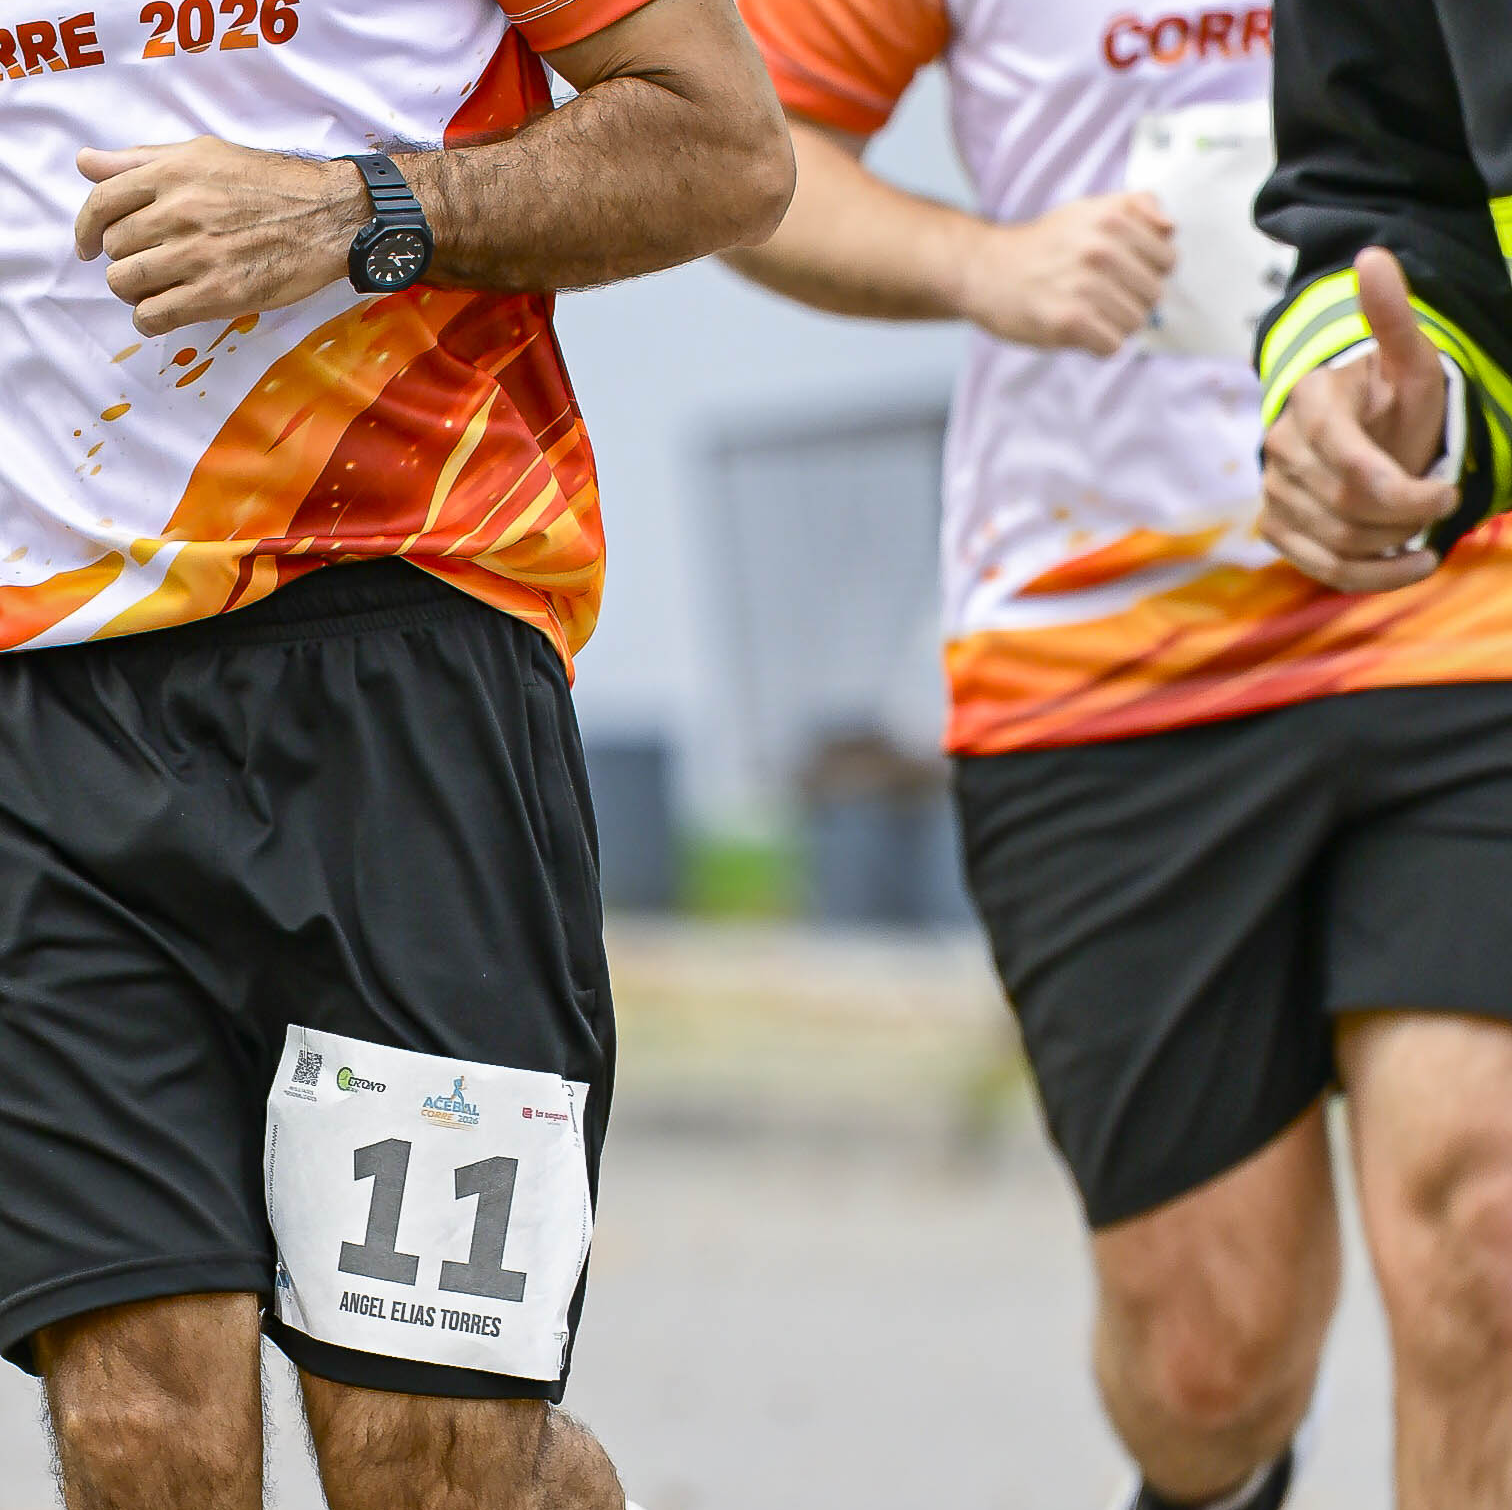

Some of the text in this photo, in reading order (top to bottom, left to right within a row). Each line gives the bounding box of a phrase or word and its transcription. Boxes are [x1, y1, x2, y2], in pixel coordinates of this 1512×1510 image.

[421, 1108, 479, 1125] CORRE 2026
[422, 1095, 480, 1117] ACEBAL
[338, 1138, 527, 1303] 11
[339, 1291, 502, 1338] ANGEL ELIAS TORRES
